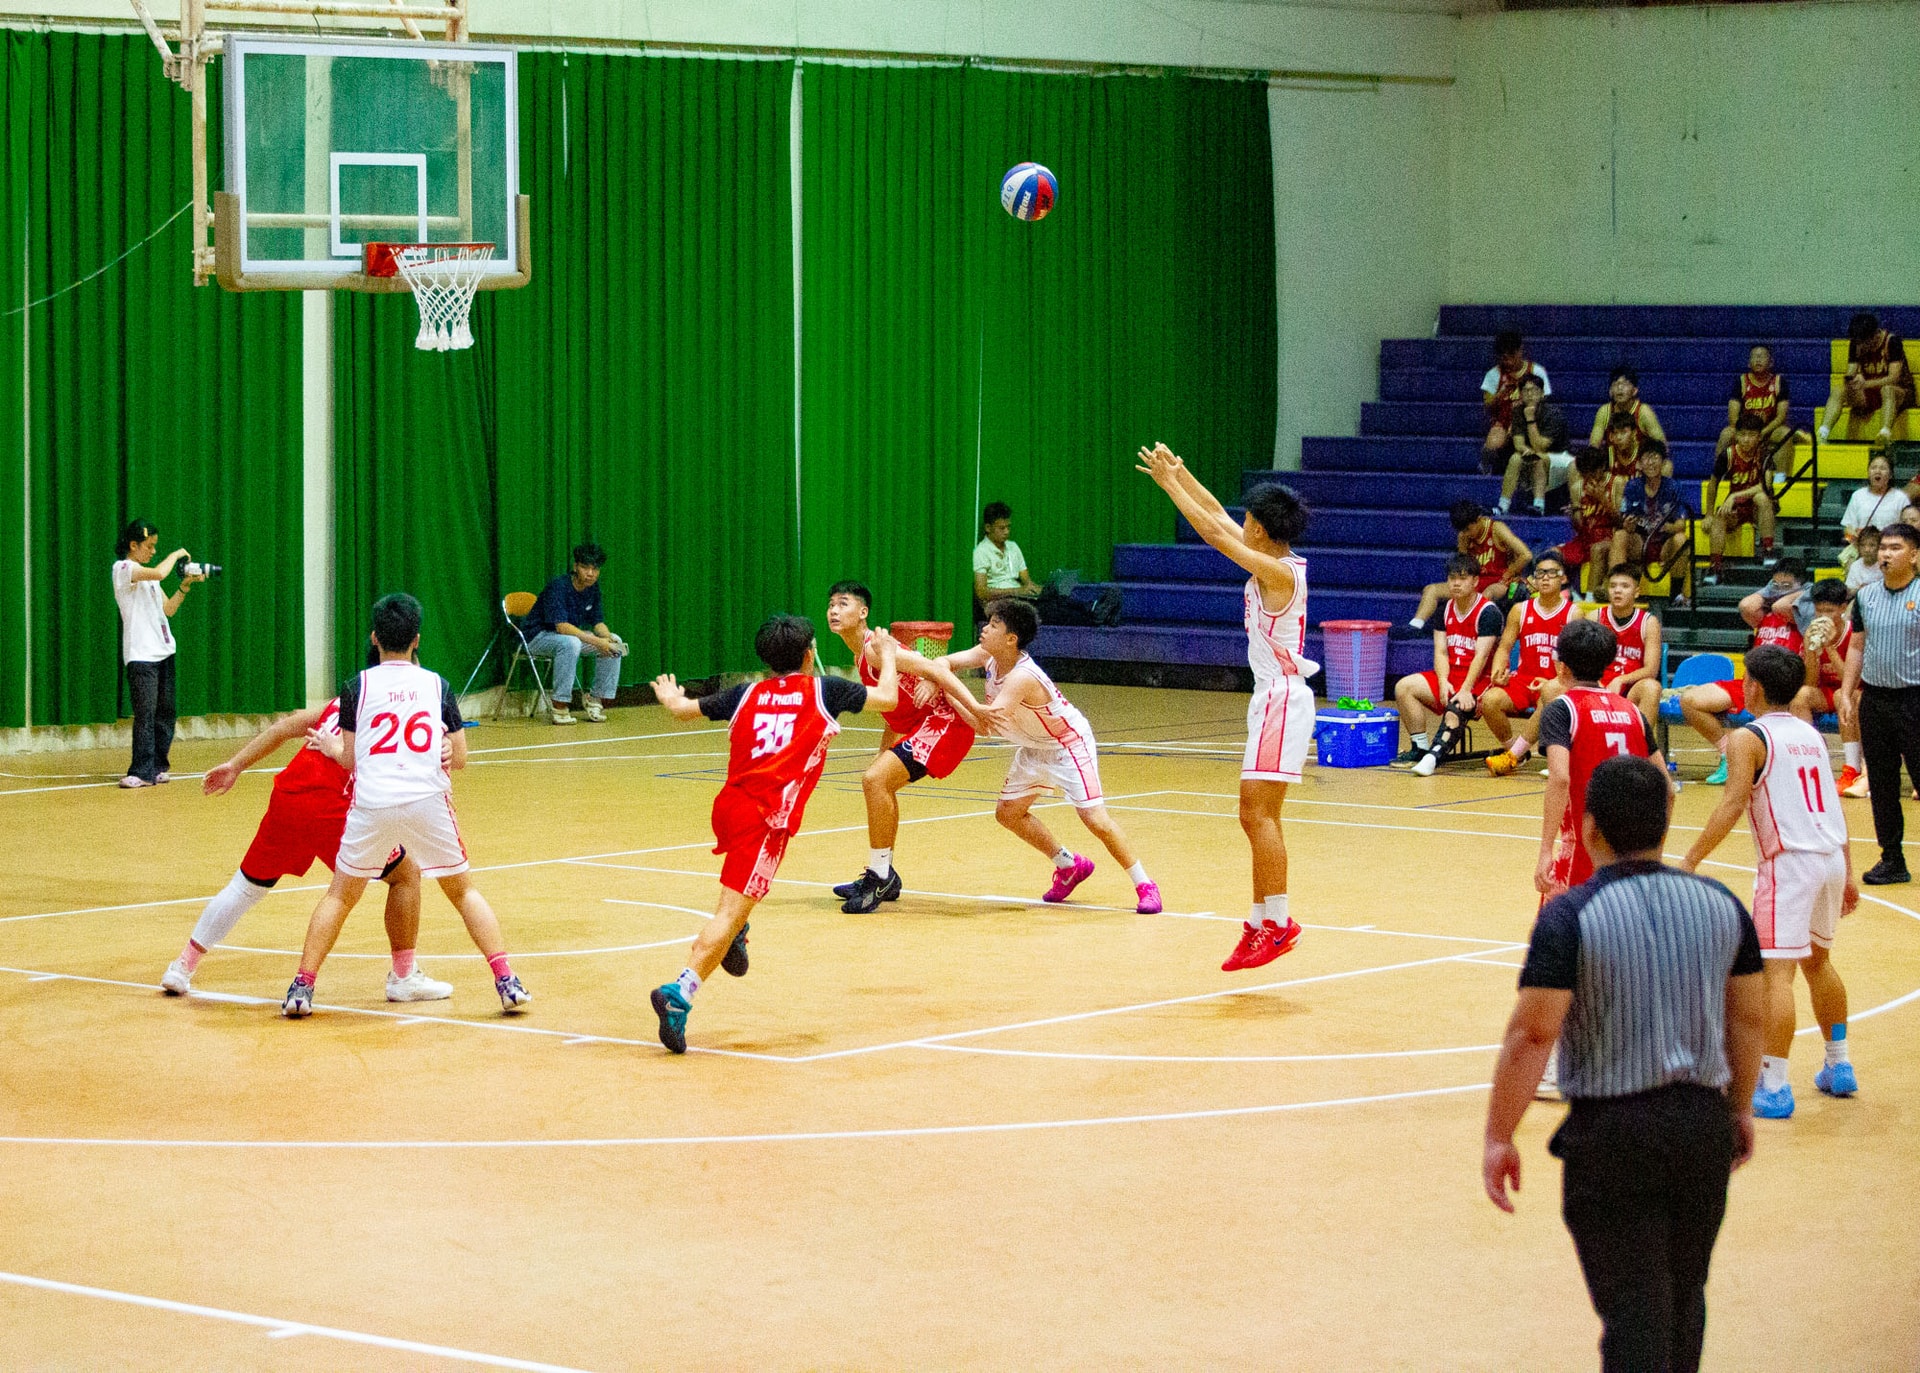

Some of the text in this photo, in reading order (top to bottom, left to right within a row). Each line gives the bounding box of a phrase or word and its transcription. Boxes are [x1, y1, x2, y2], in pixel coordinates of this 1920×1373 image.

[772, 691, 804, 706] PHONG
[369, 711, 433, 756] 26
[751, 713, 798, 759] 36
[1605, 732, 1630, 758] 7
[1797, 765, 1825, 813] 11
